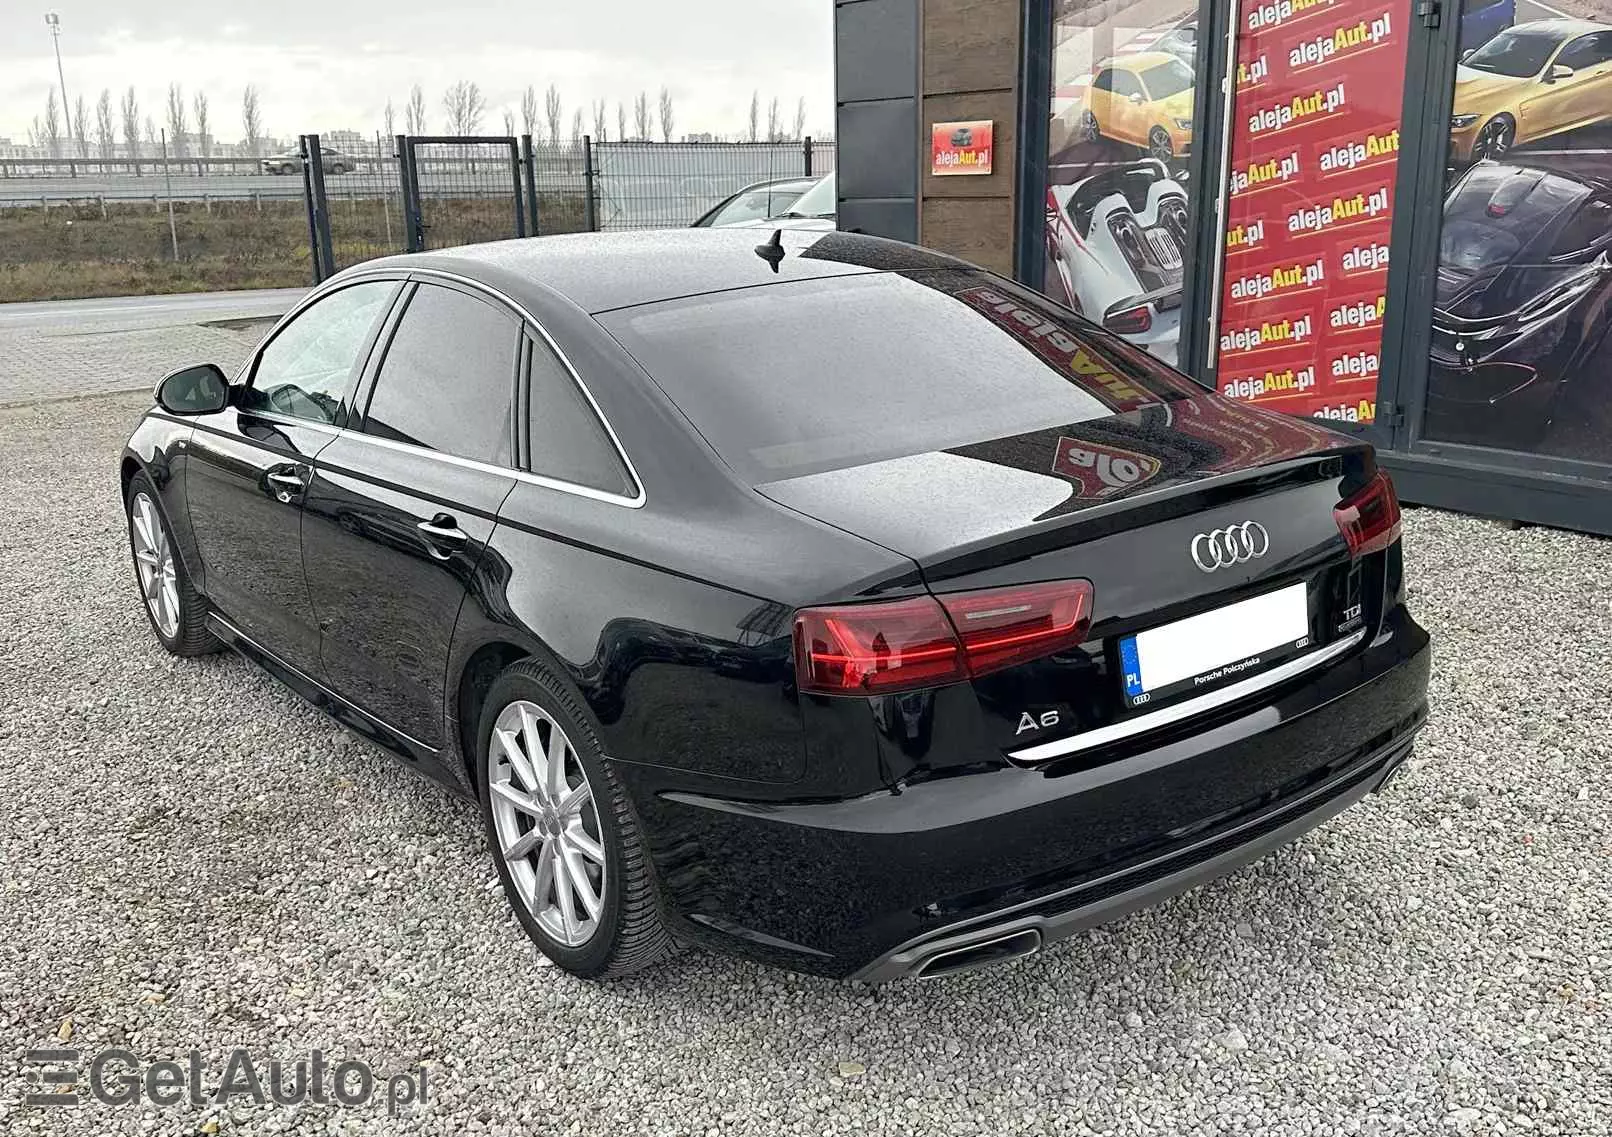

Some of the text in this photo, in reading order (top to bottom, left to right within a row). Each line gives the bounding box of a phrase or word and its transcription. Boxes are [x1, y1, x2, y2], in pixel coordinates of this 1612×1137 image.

[1289, 13, 1391, 67] alejaAut.pl
[1237, 55, 1268, 84] t.pl
[1249, 83, 1345, 132] alejaAut.pl
[935, 149, 989, 168] alejaAut.pl
[1288, 187, 1388, 231] alejaAut.pl
[1342, 242, 1389, 270] aleja
[1231, 259, 1324, 298] alejaAut.pl
[1220, 315, 1312, 351] alejaAut.pl
[1332, 351, 1380, 377] aleja
[1224, 366, 1316, 400] alejaAut.pl
[1126, 674, 1141, 688] PL
[1194, 670, 1223, 686] Porsche
[1015, 710, 1060, 735] A6
